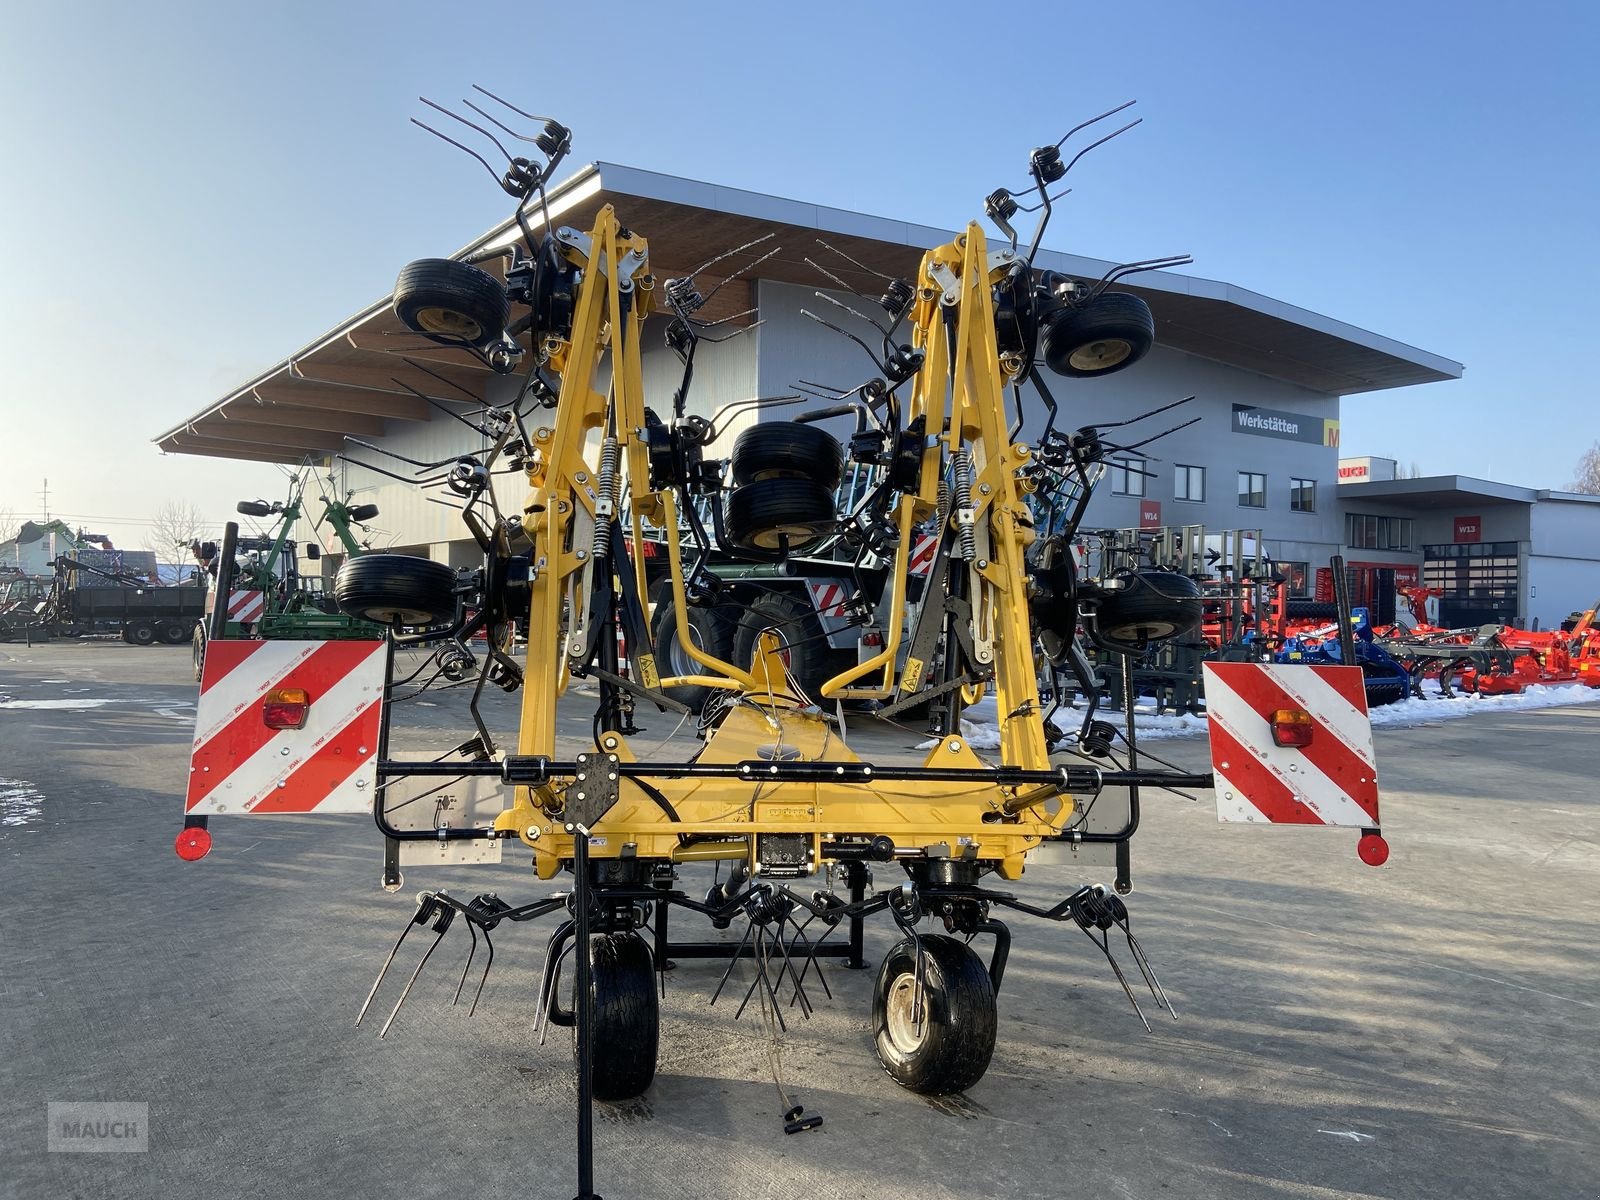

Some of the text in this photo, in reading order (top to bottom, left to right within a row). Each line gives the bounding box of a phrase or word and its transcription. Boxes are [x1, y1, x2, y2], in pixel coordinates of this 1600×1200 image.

[1238, 412, 1299, 434] Werkstätten
[1144, 511, 1158, 521] W14
[1458, 525, 1476, 534] W13
